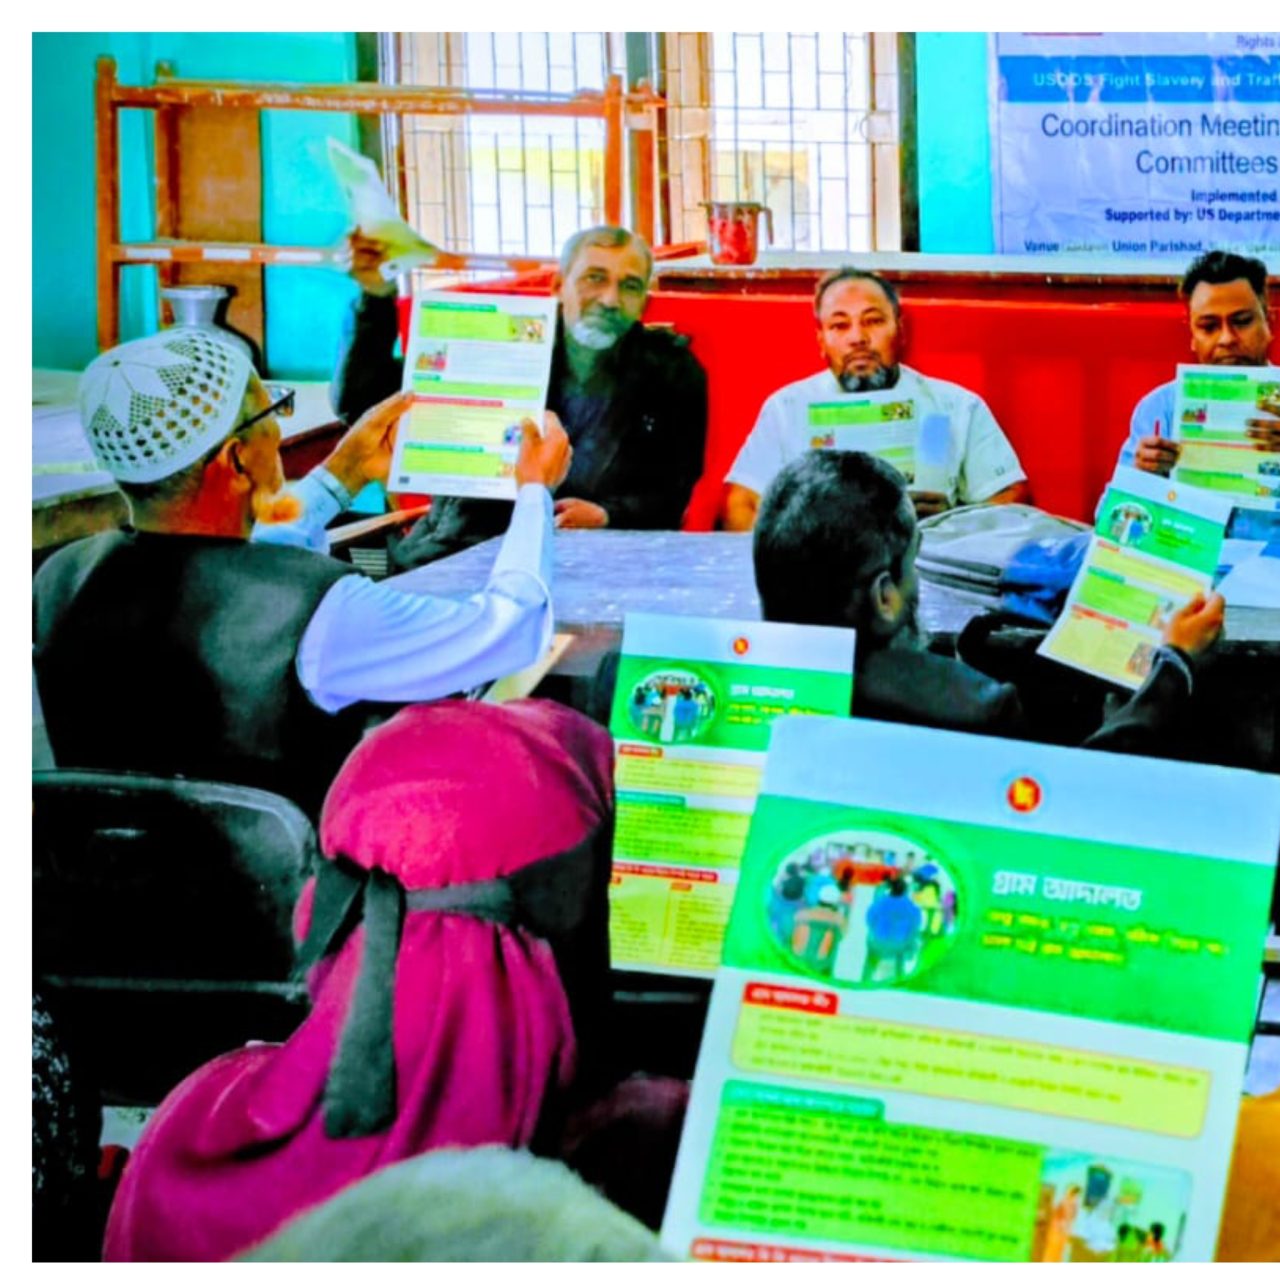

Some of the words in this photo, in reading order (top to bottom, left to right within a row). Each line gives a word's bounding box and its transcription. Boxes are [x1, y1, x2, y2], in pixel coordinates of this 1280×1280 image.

[1099, 72, 1141, 90] Fight
[1145, 72, 1206, 90] Slavery
[1211, 72, 1241, 87] and
[1041, 113, 1193, 138] Coordination
[1136, 150, 1279, 174] Committees
[1191, 189, 1277, 205] Implemented
[1105, 208, 1170, 223] Supported
[1174, 208, 1193, 223] by:
[1197, 208, 1215, 221] US
[1111, 240, 1147, 252] Union
